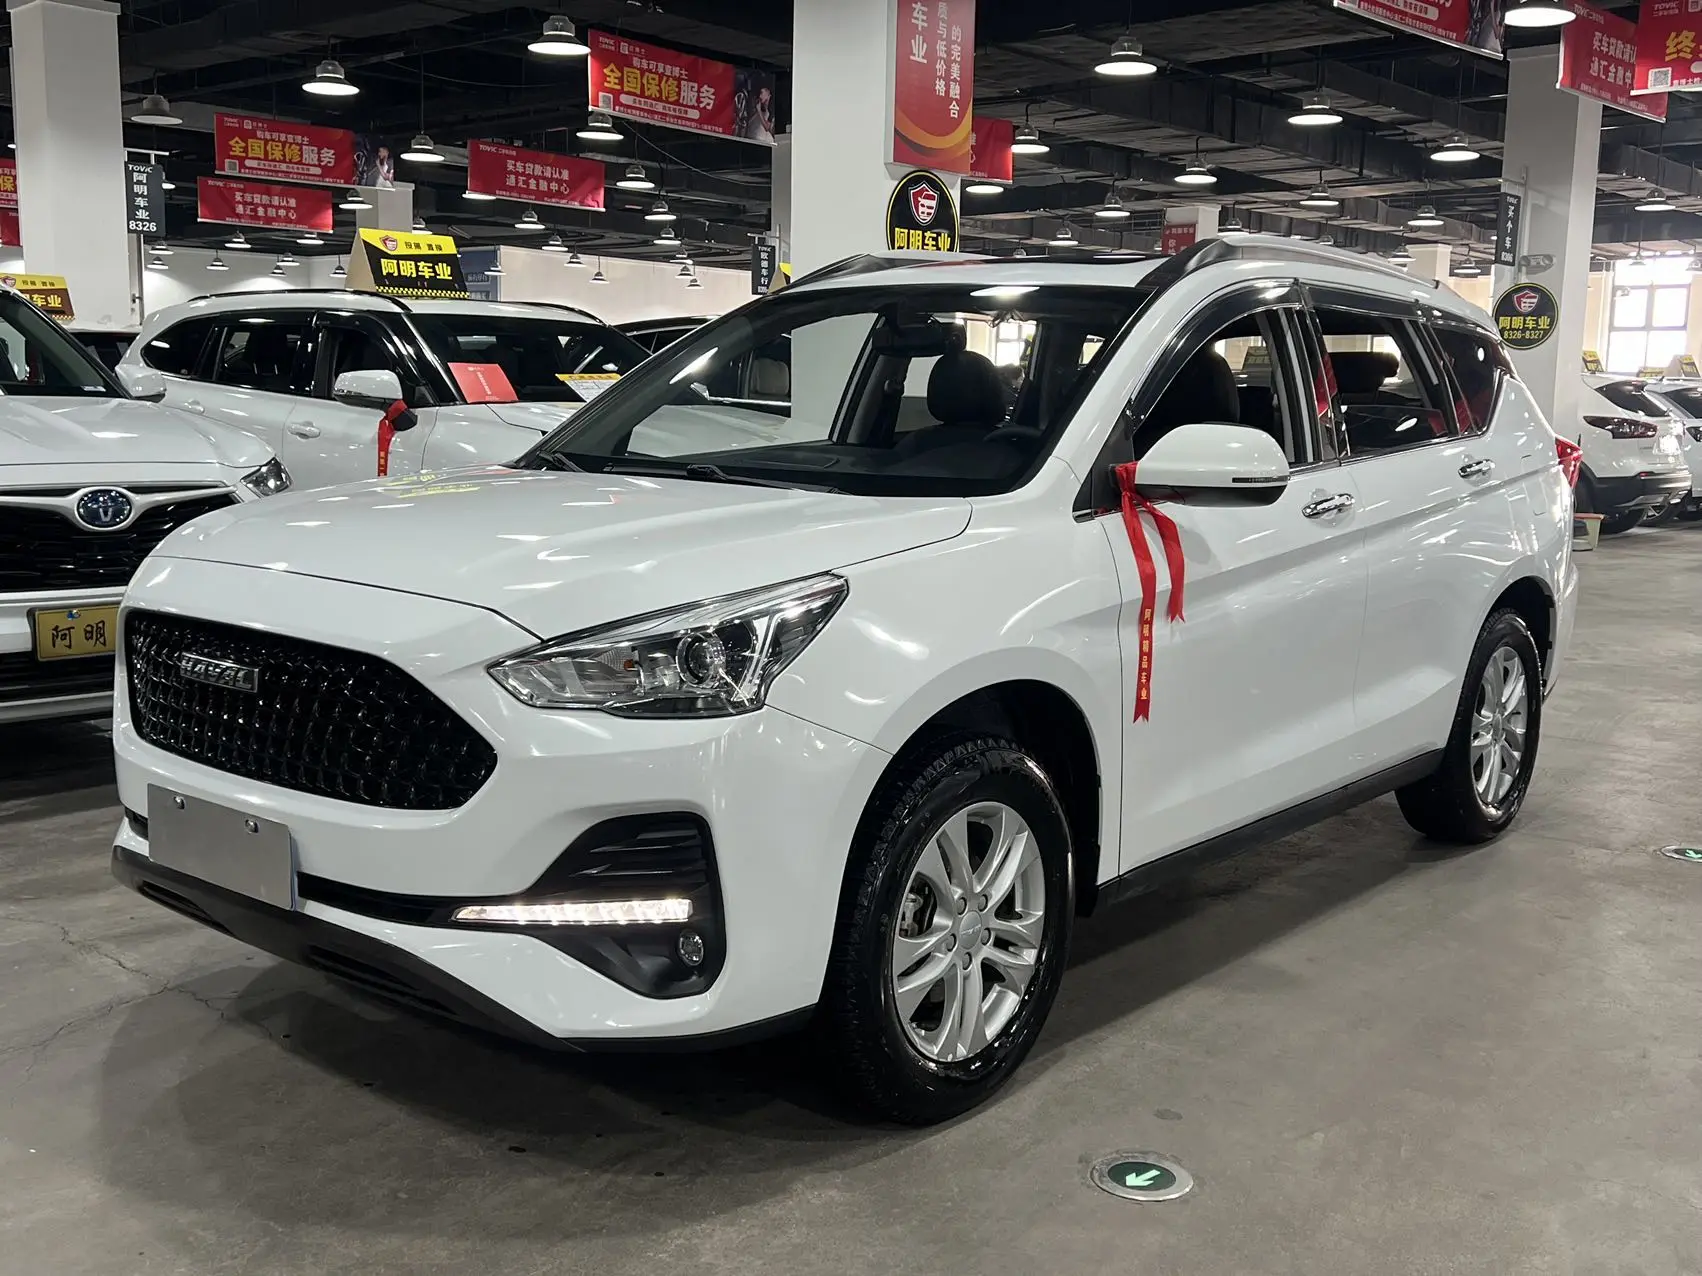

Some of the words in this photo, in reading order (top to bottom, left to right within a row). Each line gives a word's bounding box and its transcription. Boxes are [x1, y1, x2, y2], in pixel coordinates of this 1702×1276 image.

[910, 2, 928, 64] 车业
[950, 25, 962, 119] 的完美融合
[603, 62, 715, 110] 全国保修服务
[228, 136, 335, 167] 全国保修服务
[128, 164, 153, 173] TOVIC
[506, 159, 569, 180] 买车贷款请认准
[506, 174, 569, 194] 通汇金融中心
[133, 172, 150, 220] 阿明车业
[235, 191, 297, 207] 买车贷款请认准
[235, 203, 297, 219] 通汇金融中心
[129, 220, 157, 231] 8326
[894, 227, 951, 252] 阿明车业
[380, 258, 453, 280] 阿明车业
[1499, 316, 1550, 330] 阿明车业
[1503, 330, 1544, 340] 8326-8327
[51, 620, 106, 649] 阿明
